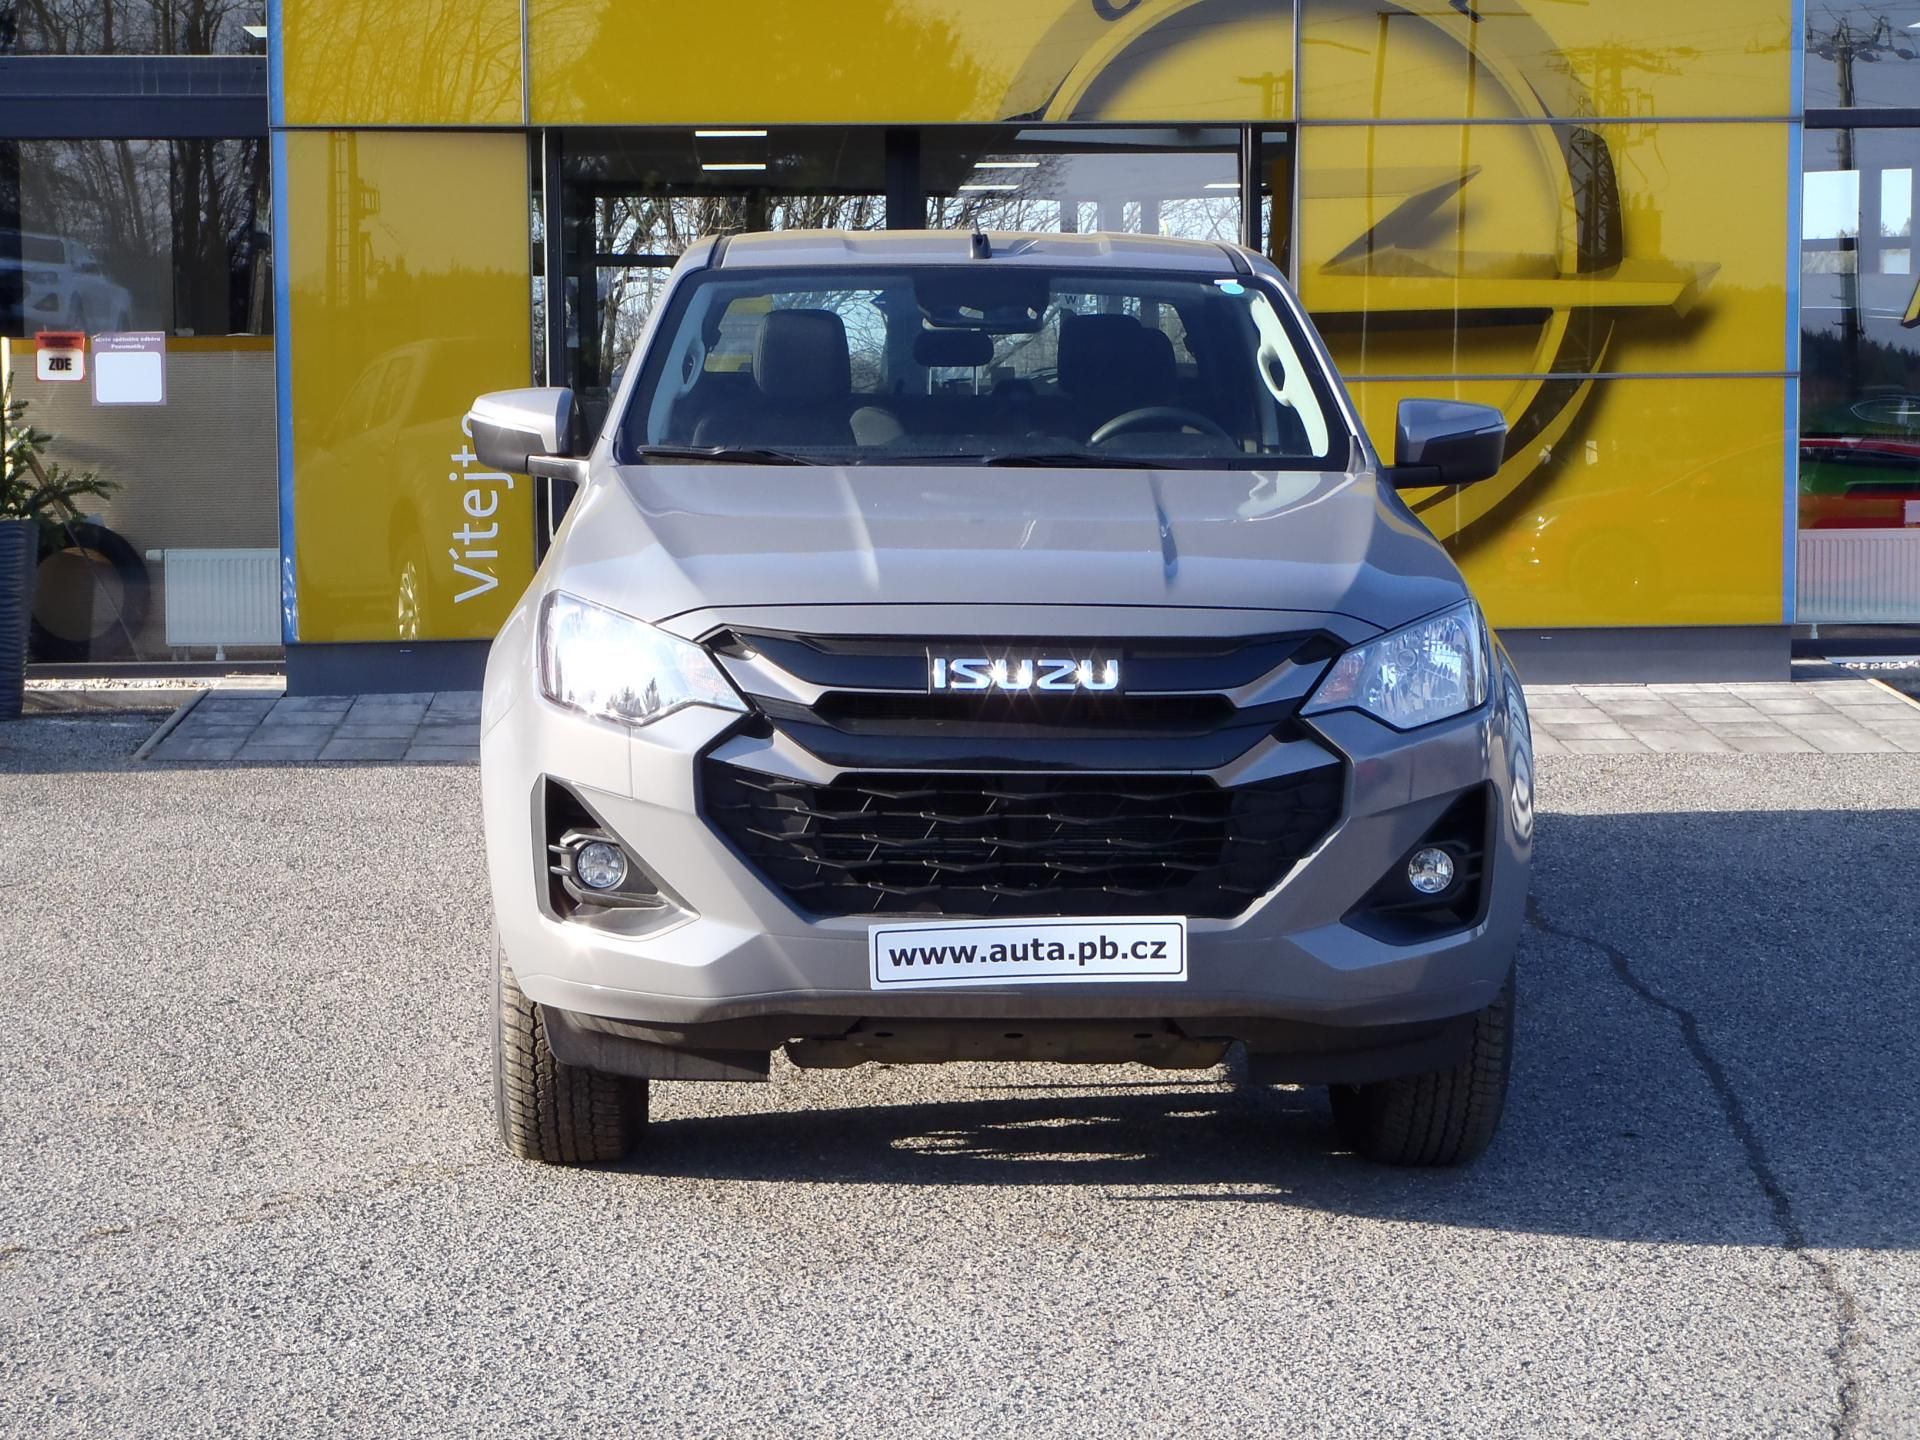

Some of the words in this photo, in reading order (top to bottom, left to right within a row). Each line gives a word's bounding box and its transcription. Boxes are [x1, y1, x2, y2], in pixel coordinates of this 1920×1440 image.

[48, 357, 72, 371] ZDE
[933, 658, 1119, 690] ISUZU
[888, 935, 1167, 967] www.auta.pb.cz
